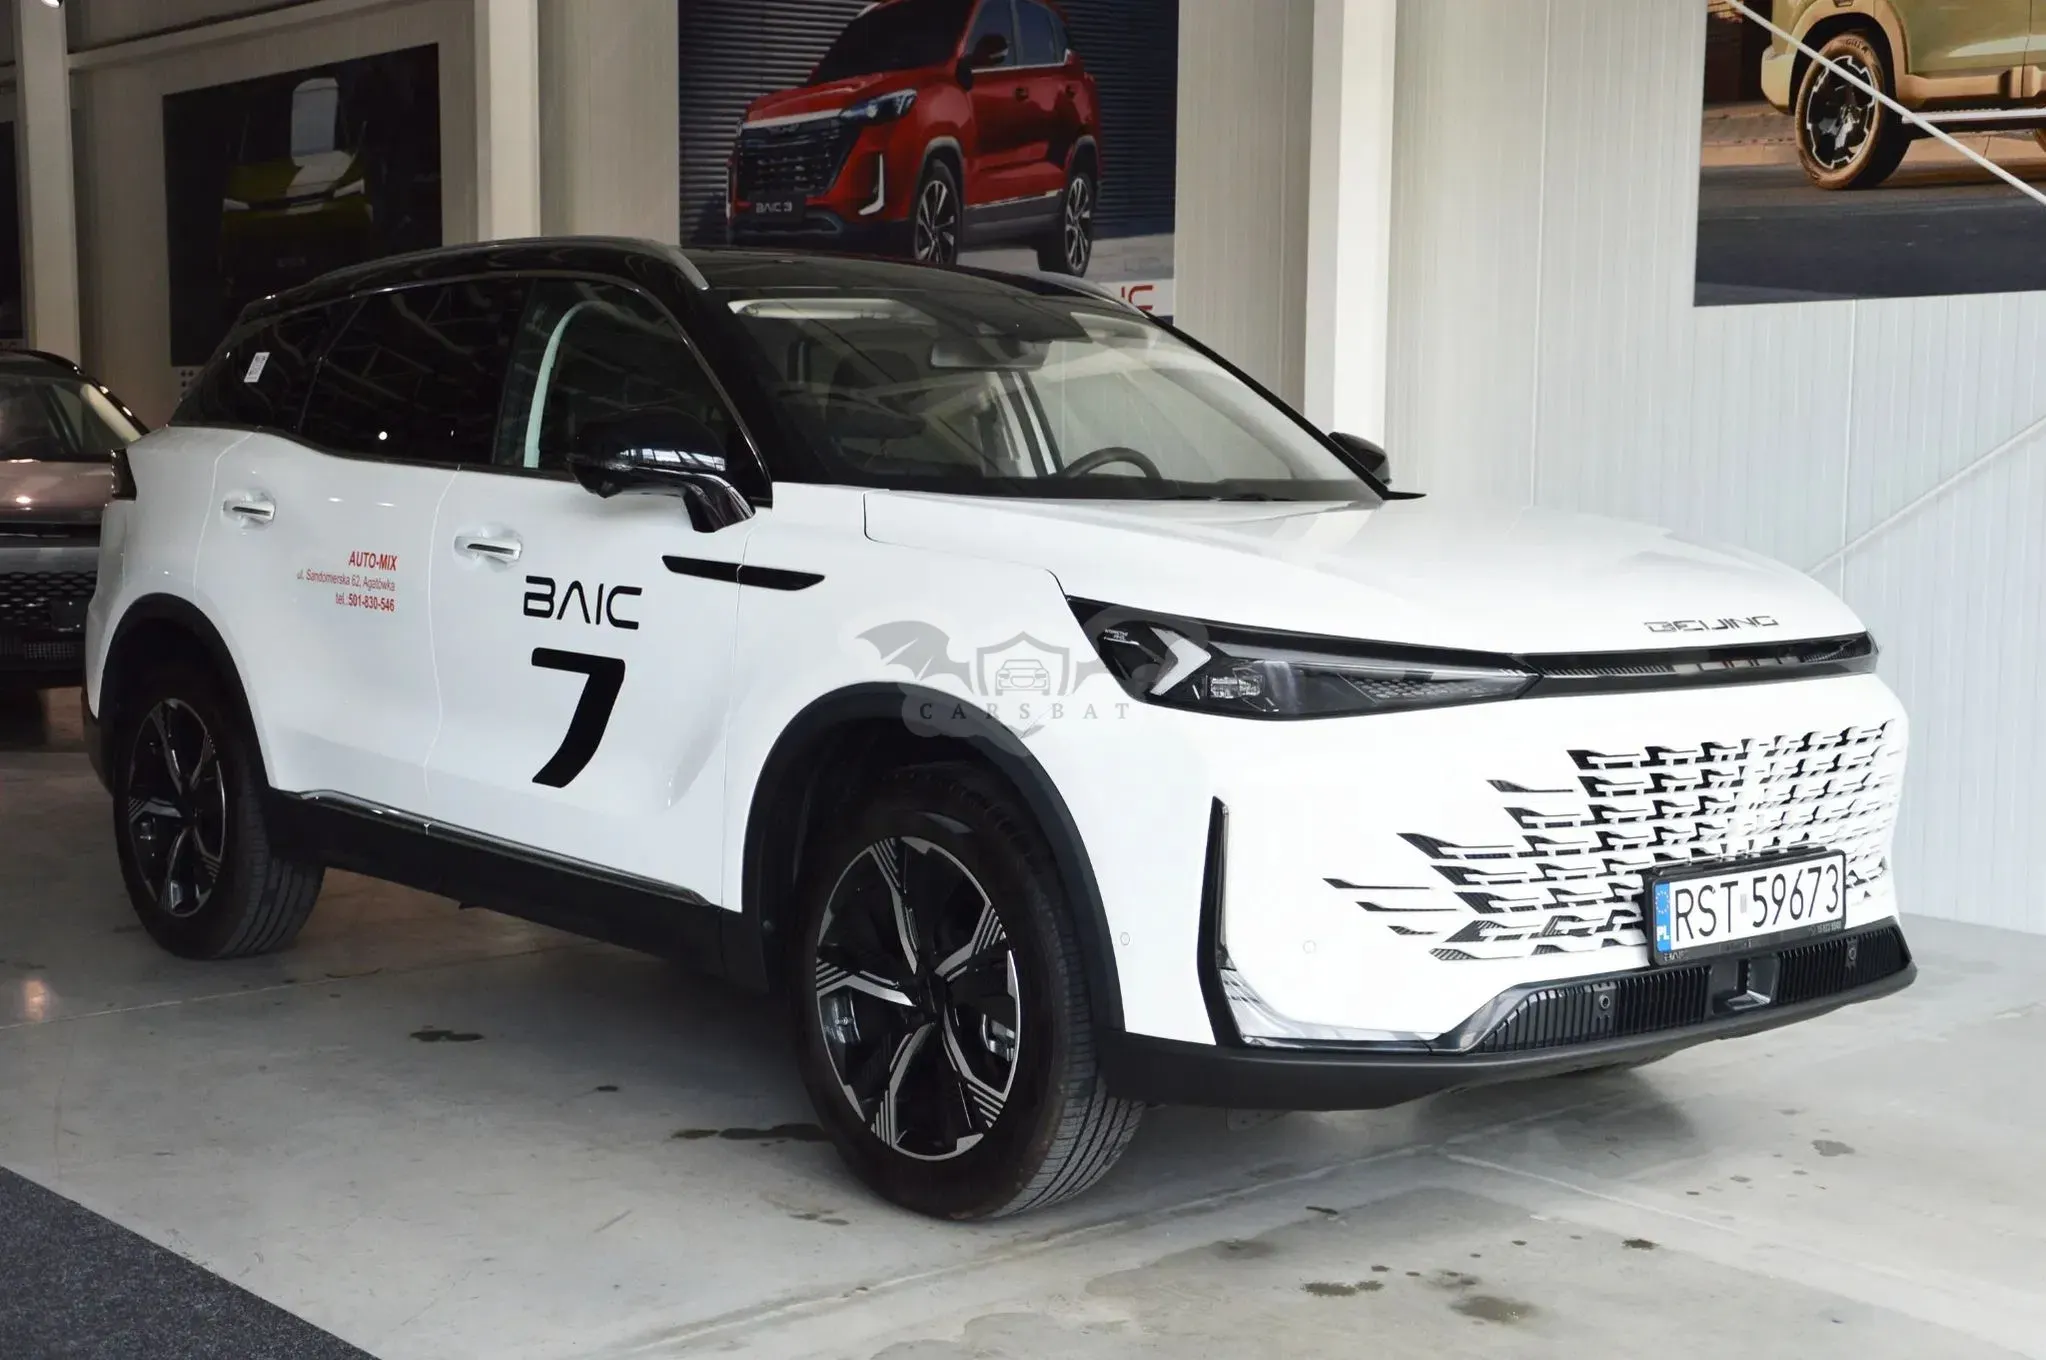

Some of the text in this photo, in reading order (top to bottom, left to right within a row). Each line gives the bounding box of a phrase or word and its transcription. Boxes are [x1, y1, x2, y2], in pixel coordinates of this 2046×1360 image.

[349, 551, 397, 571] AUTO-MIX
[306, 568, 350, 585] Sandomierska
[348, 592, 394, 611] 501-830-546
[523, 575, 643, 630] BAIC
[1644, 615, 1779, 632] BEIJING
[531, 647, 626, 788] 7
[1675, 863, 1839, 942] RST 59673
